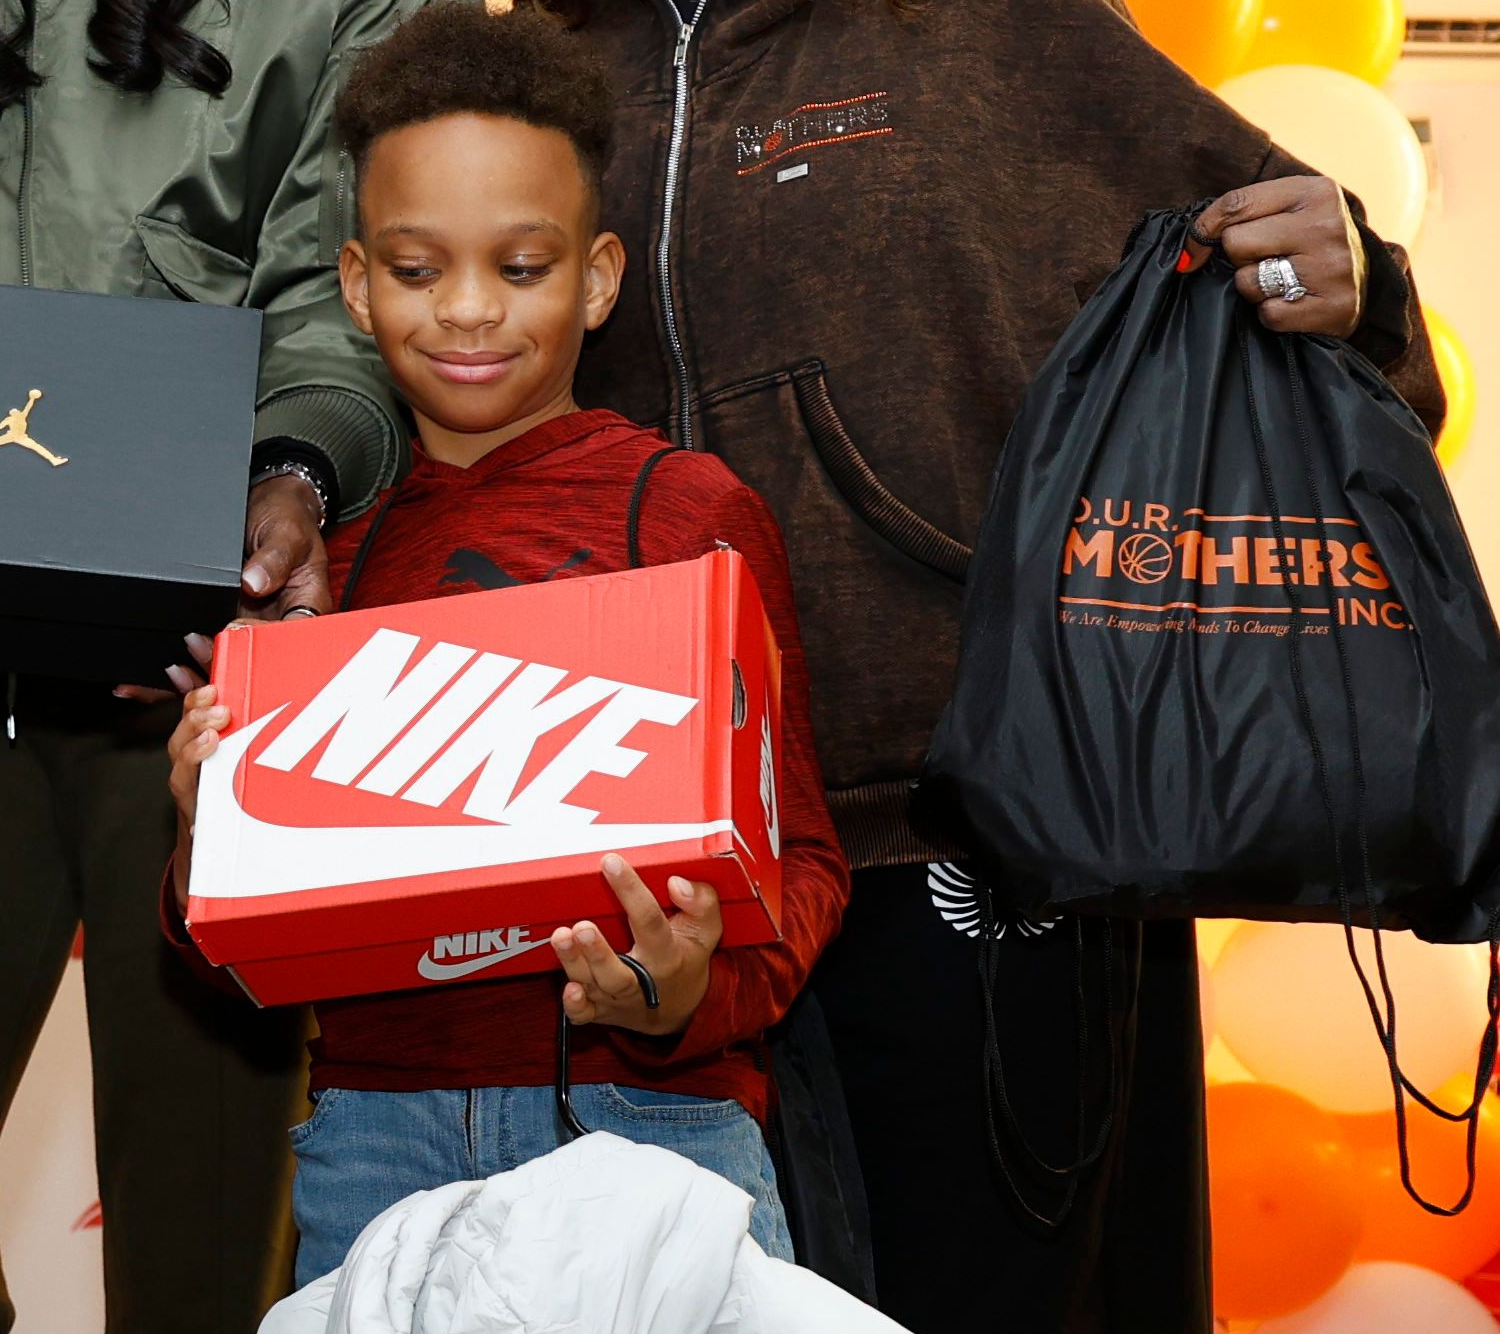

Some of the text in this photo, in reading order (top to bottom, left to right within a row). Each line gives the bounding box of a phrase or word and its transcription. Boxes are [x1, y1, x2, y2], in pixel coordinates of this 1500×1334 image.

[1061, 527, 1391, 591] MOTHERS
[1078, 610, 1104, 627] Are
[1223, 618, 1241, 635] To
[1336, 595, 1415, 631] INC.
[254, 627, 699, 826] NIKE
[432, 925, 533, 960] NIKE
